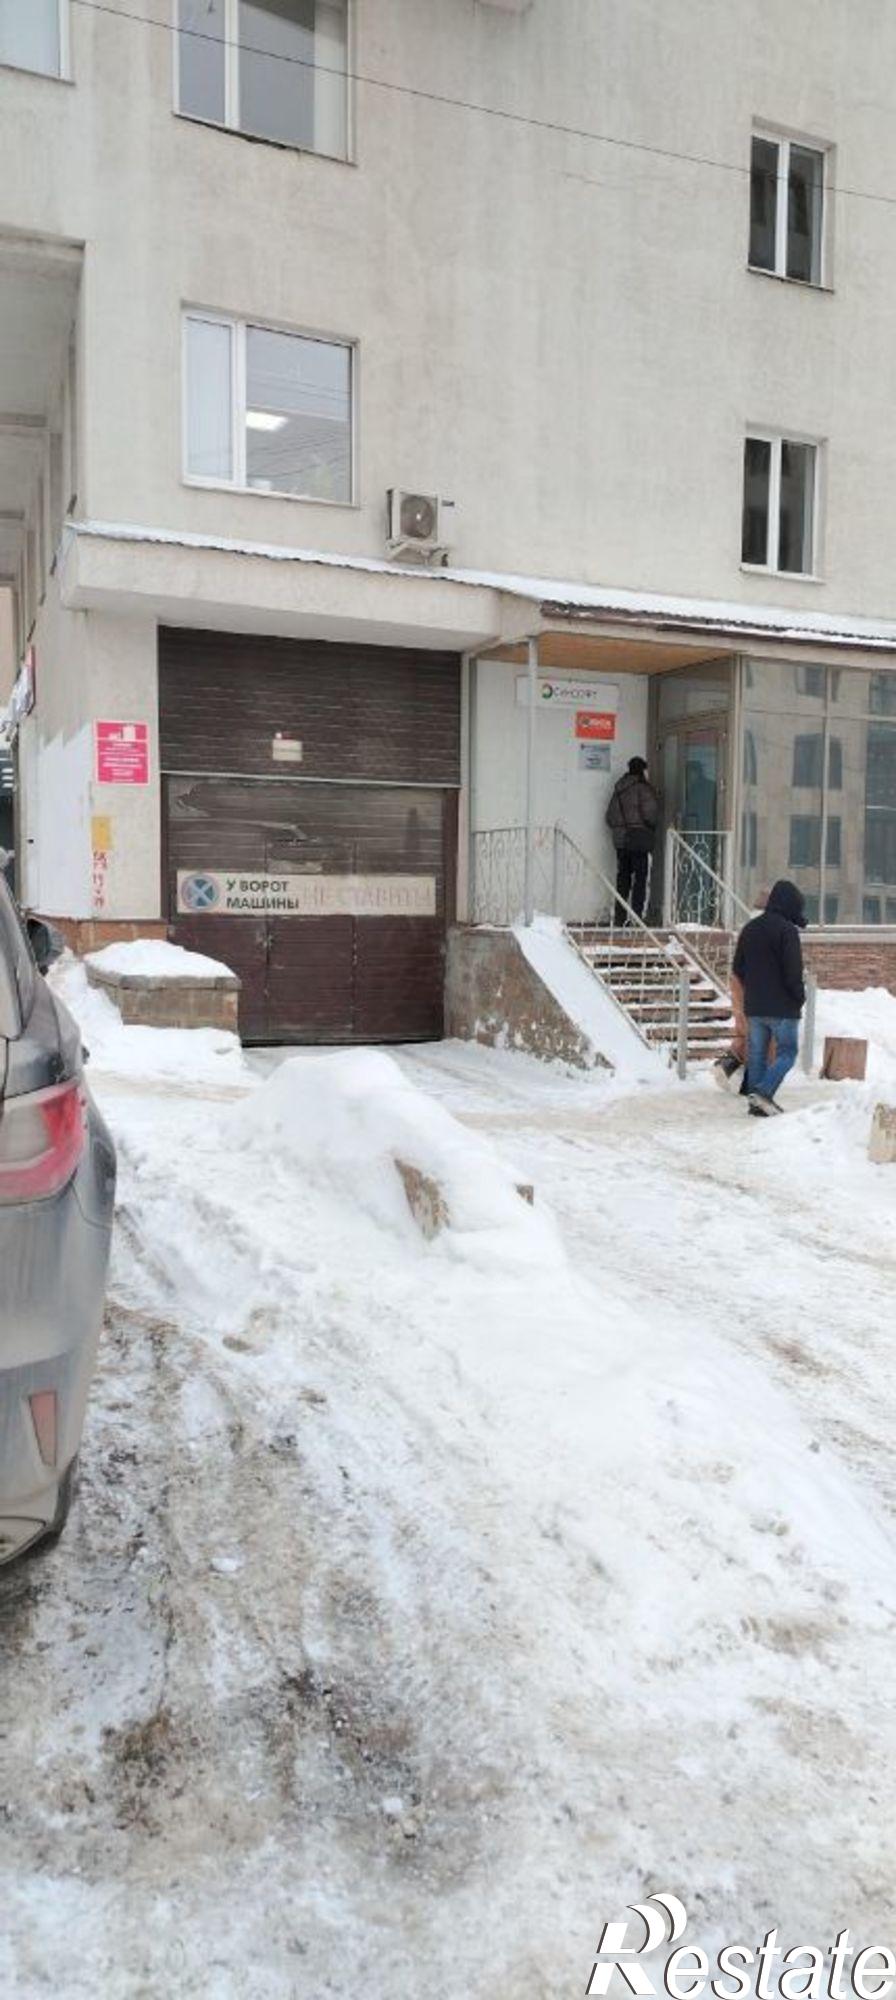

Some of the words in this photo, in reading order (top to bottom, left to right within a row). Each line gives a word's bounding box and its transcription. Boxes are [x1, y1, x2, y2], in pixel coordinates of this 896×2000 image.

[226, 880, 236, 891] У
[240, 880, 289, 892] ВОРОТ
[226, 897, 299, 909] МАШИНЫ
